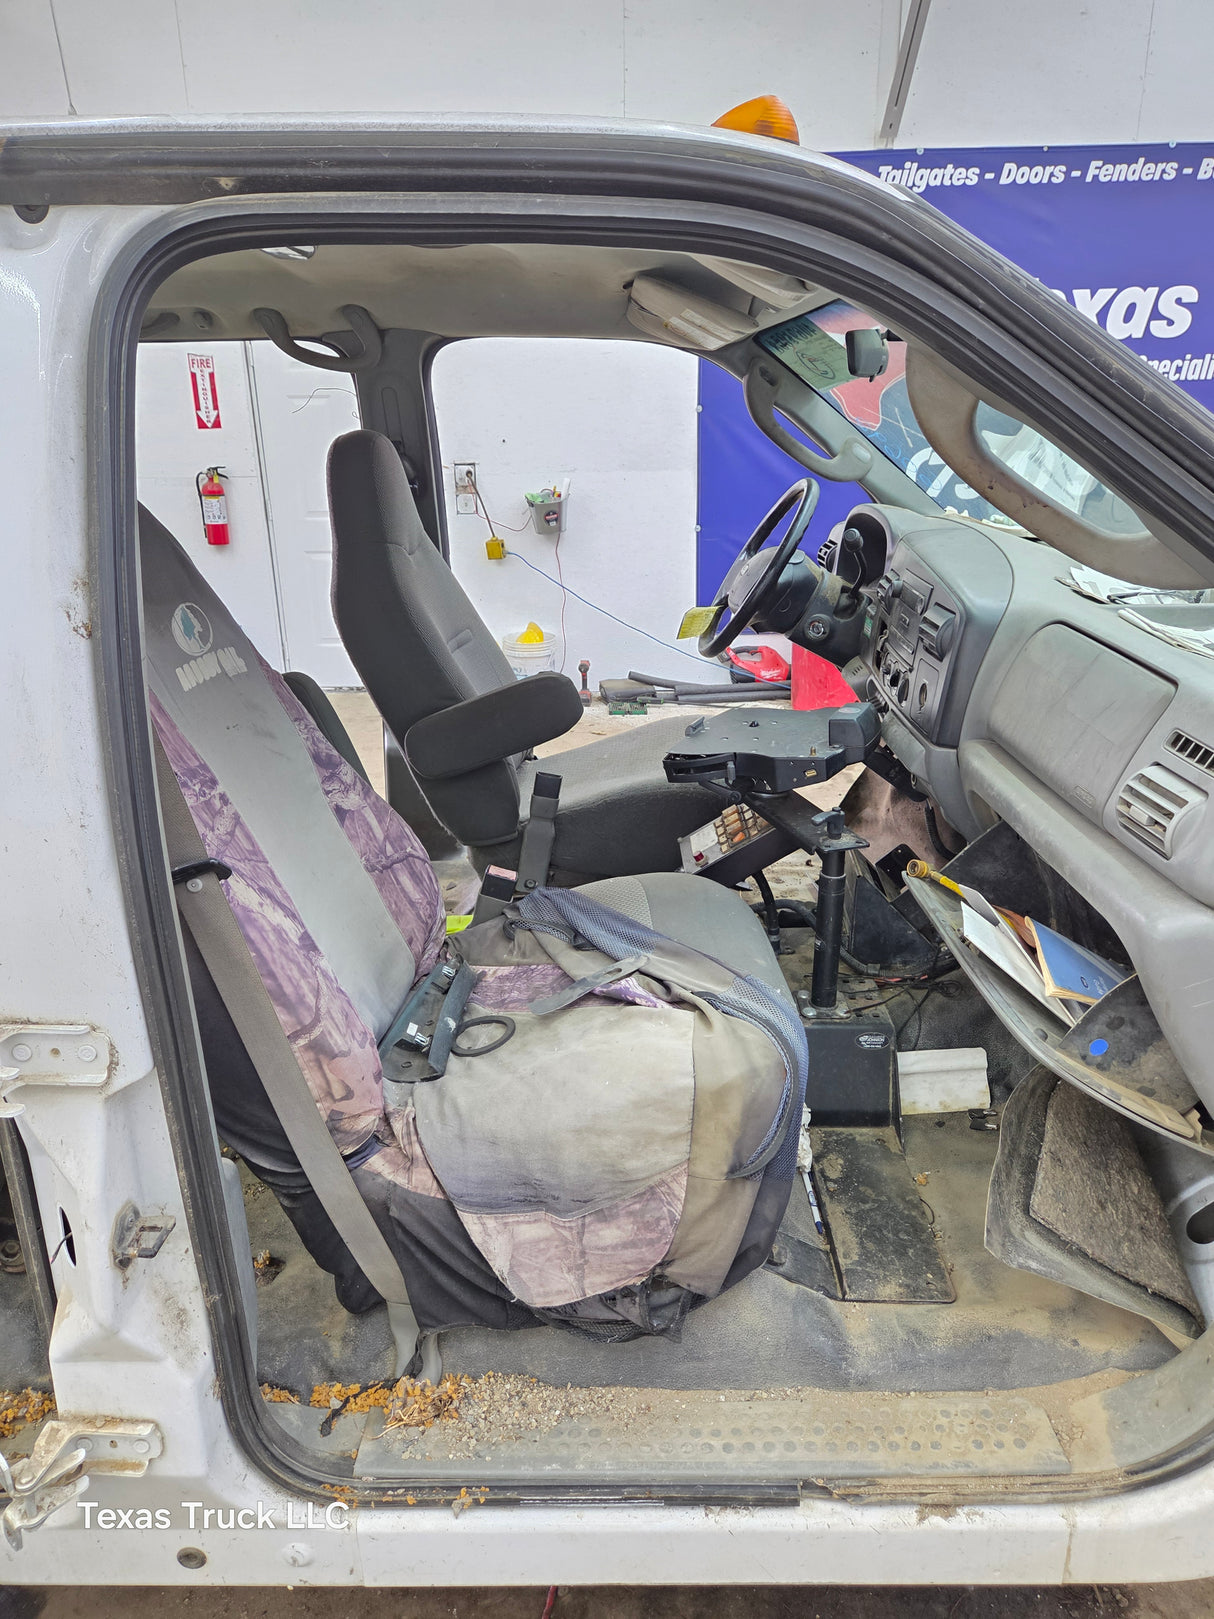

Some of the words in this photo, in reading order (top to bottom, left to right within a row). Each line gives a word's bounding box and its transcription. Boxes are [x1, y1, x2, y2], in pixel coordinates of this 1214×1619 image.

[879, 161, 980, 193] Tailgates
[999, 162, 1067, 185] Doors
[1085, 157, 1178, 183] Fenders
[1197, 157, 1214, 181] B
[1049, 284, 1199, 341] xas
[191, 358, 211, 369] FIRE
